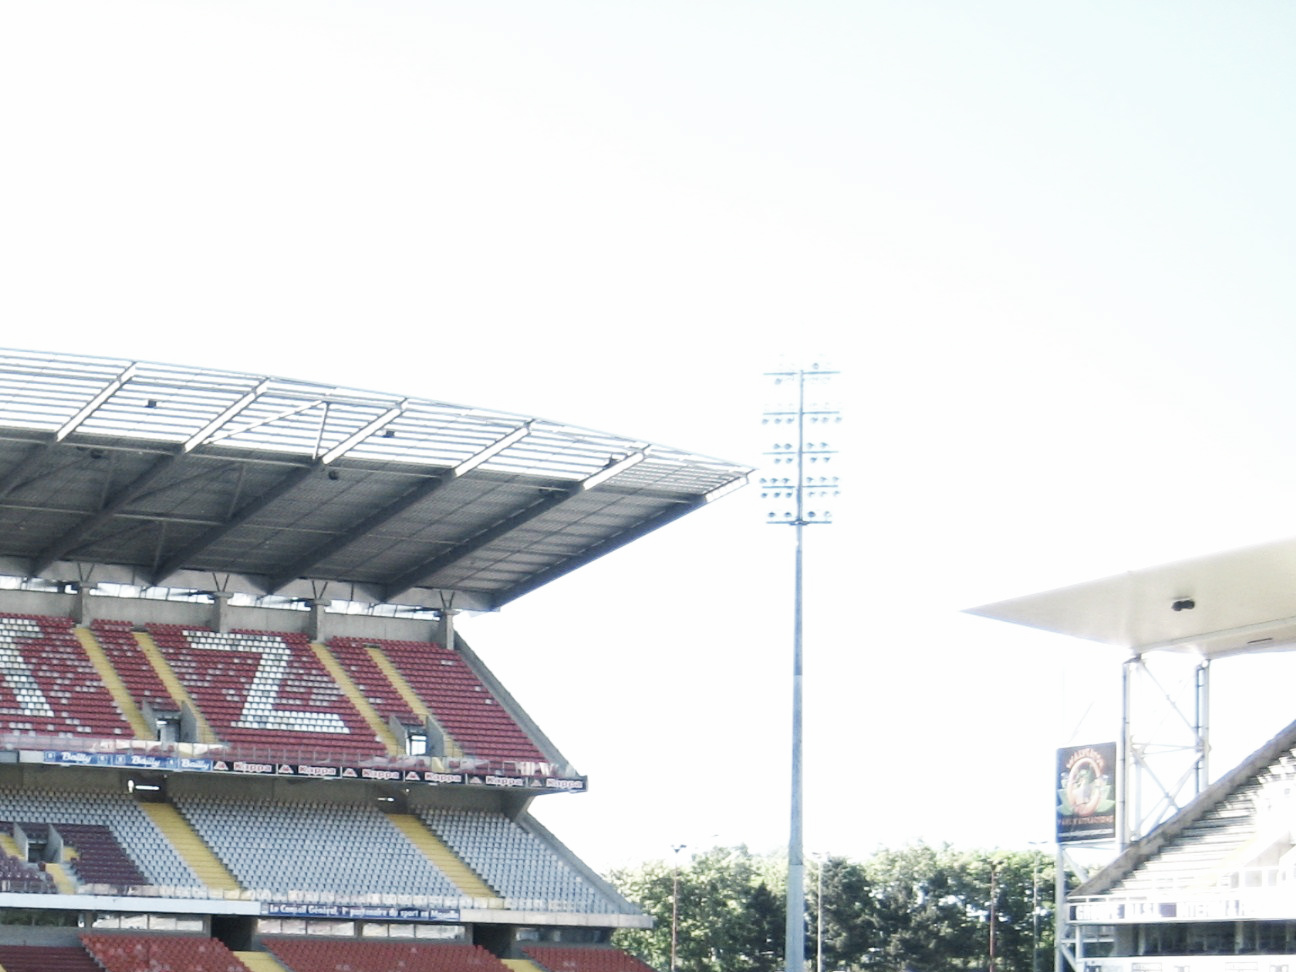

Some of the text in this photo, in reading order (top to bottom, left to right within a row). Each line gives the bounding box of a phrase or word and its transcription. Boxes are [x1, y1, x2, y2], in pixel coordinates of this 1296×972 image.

[233, 761, 273, 774] Kappa
[298, 765, 337, 778] Kappa
[361, 768, 400, 781] Kappa
[424, 771, 462, 784] Kappa
[485, 775, 523, 788] Kappa
[546, 778, 584, 790] Kappa
